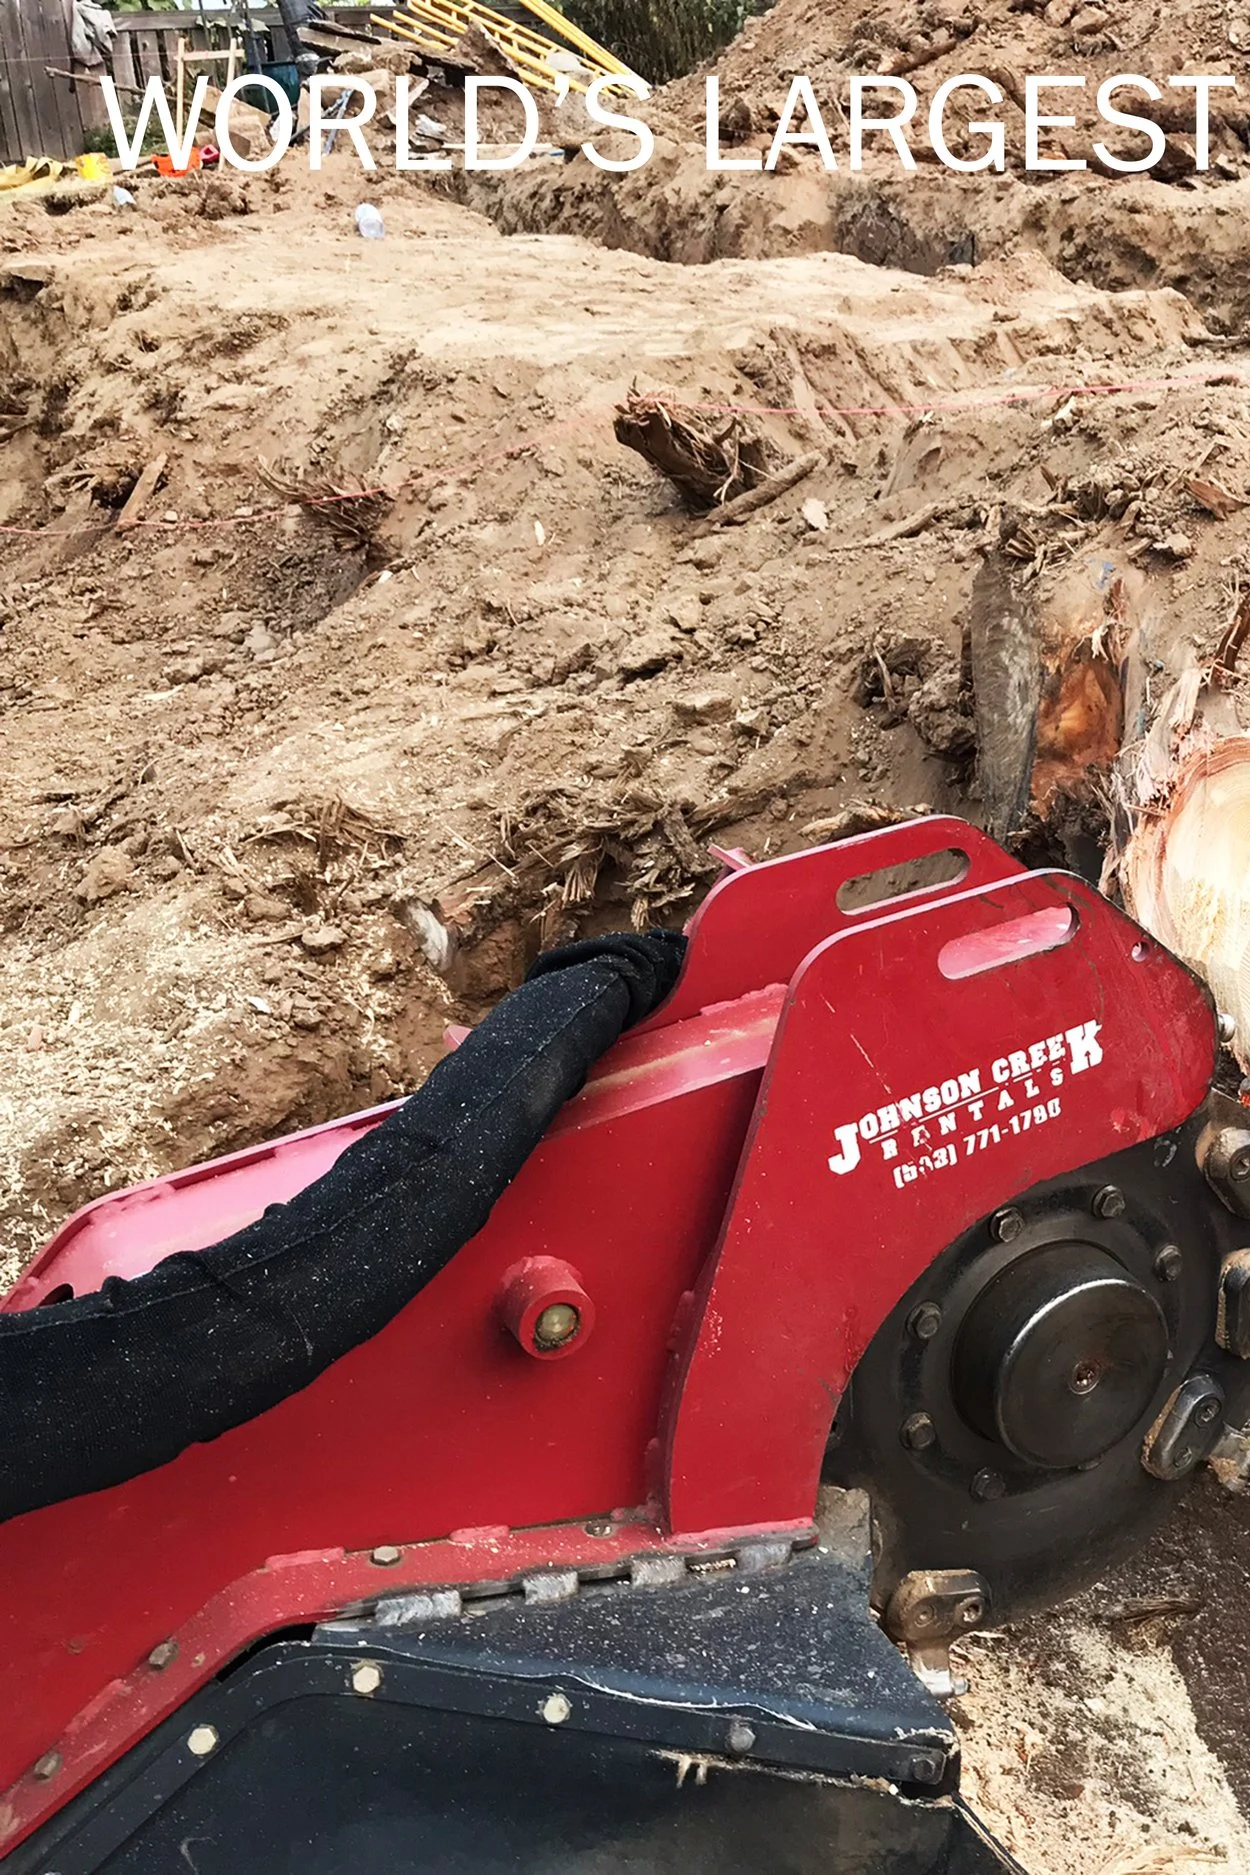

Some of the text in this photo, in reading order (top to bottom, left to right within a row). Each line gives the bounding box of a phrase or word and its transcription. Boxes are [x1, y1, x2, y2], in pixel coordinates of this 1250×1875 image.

[828, 1019, 1103, 1175] JOHNSON CREEK
[881, 1067, 1064, 1161] RENTALS
